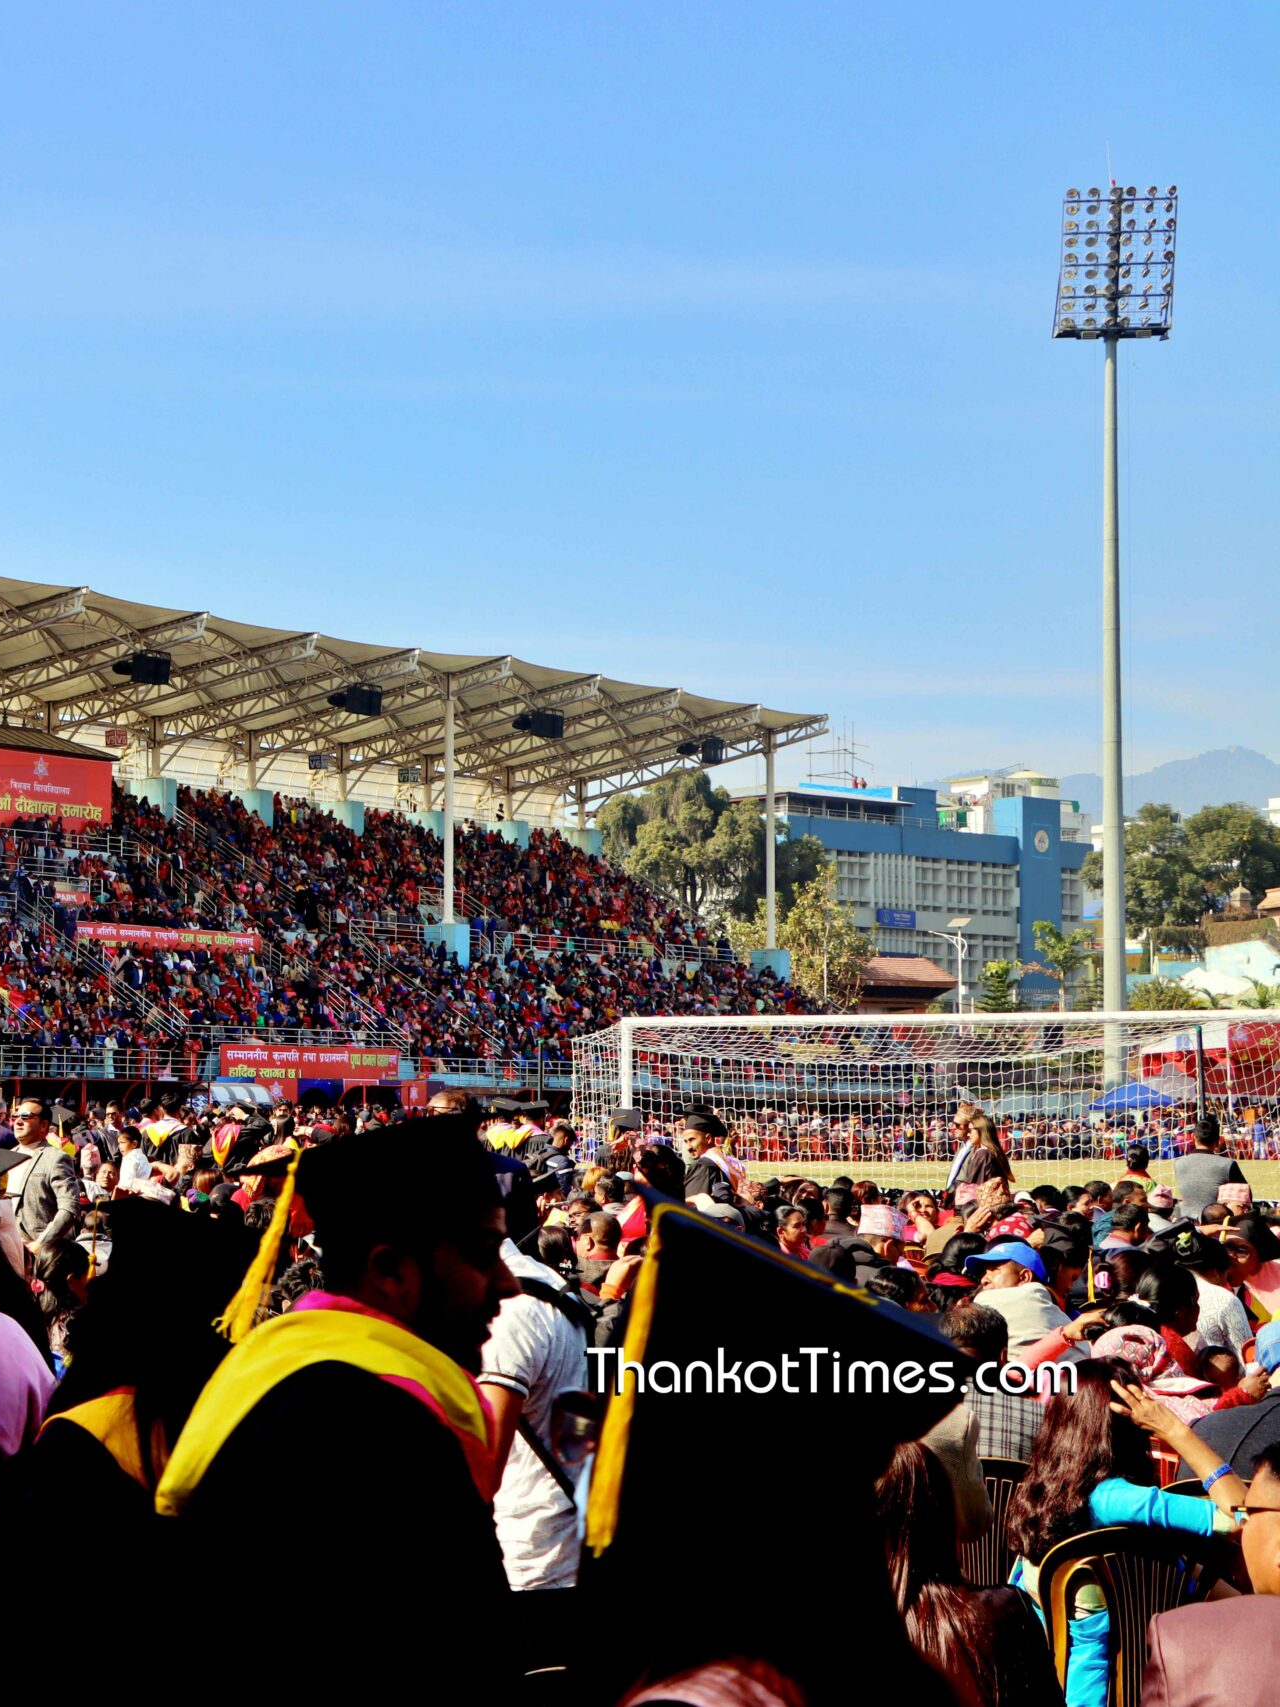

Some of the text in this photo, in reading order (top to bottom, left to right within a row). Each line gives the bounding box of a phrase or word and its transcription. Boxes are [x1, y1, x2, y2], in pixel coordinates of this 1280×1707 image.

[60, 802, 103, 821] समारोह
[272, 1049, 300, 1065] कुलपति
[302, 1052, 317, 1062] तथा
